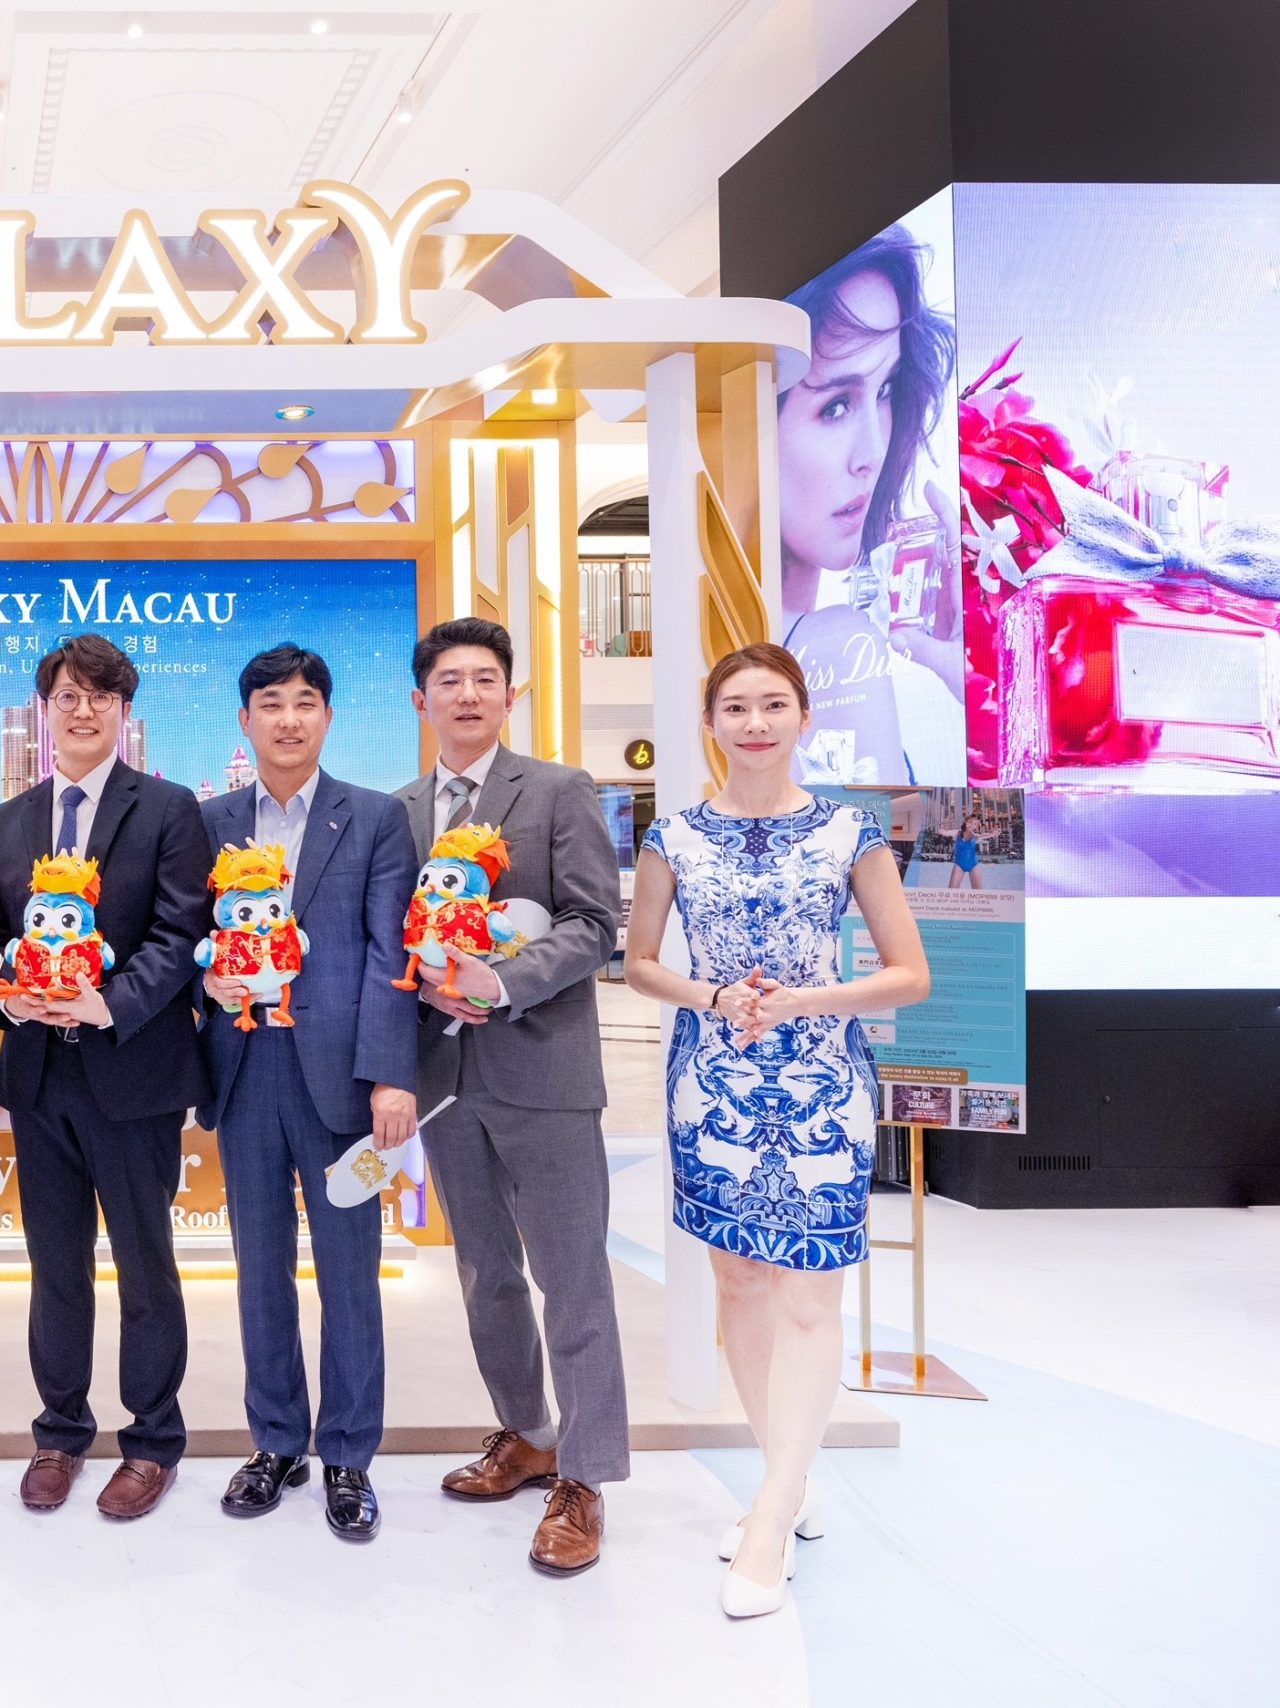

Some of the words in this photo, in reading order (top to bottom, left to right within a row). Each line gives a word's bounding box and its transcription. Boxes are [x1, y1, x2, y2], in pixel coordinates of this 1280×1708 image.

[58, 577, 237, 625] MACAU
[123, 635, 157, 653] 경험
[133, 659, 208, 673] eriences
[816, 700, 833, 710] NEW
[908, 1101, 935, 1110] CULTURE
